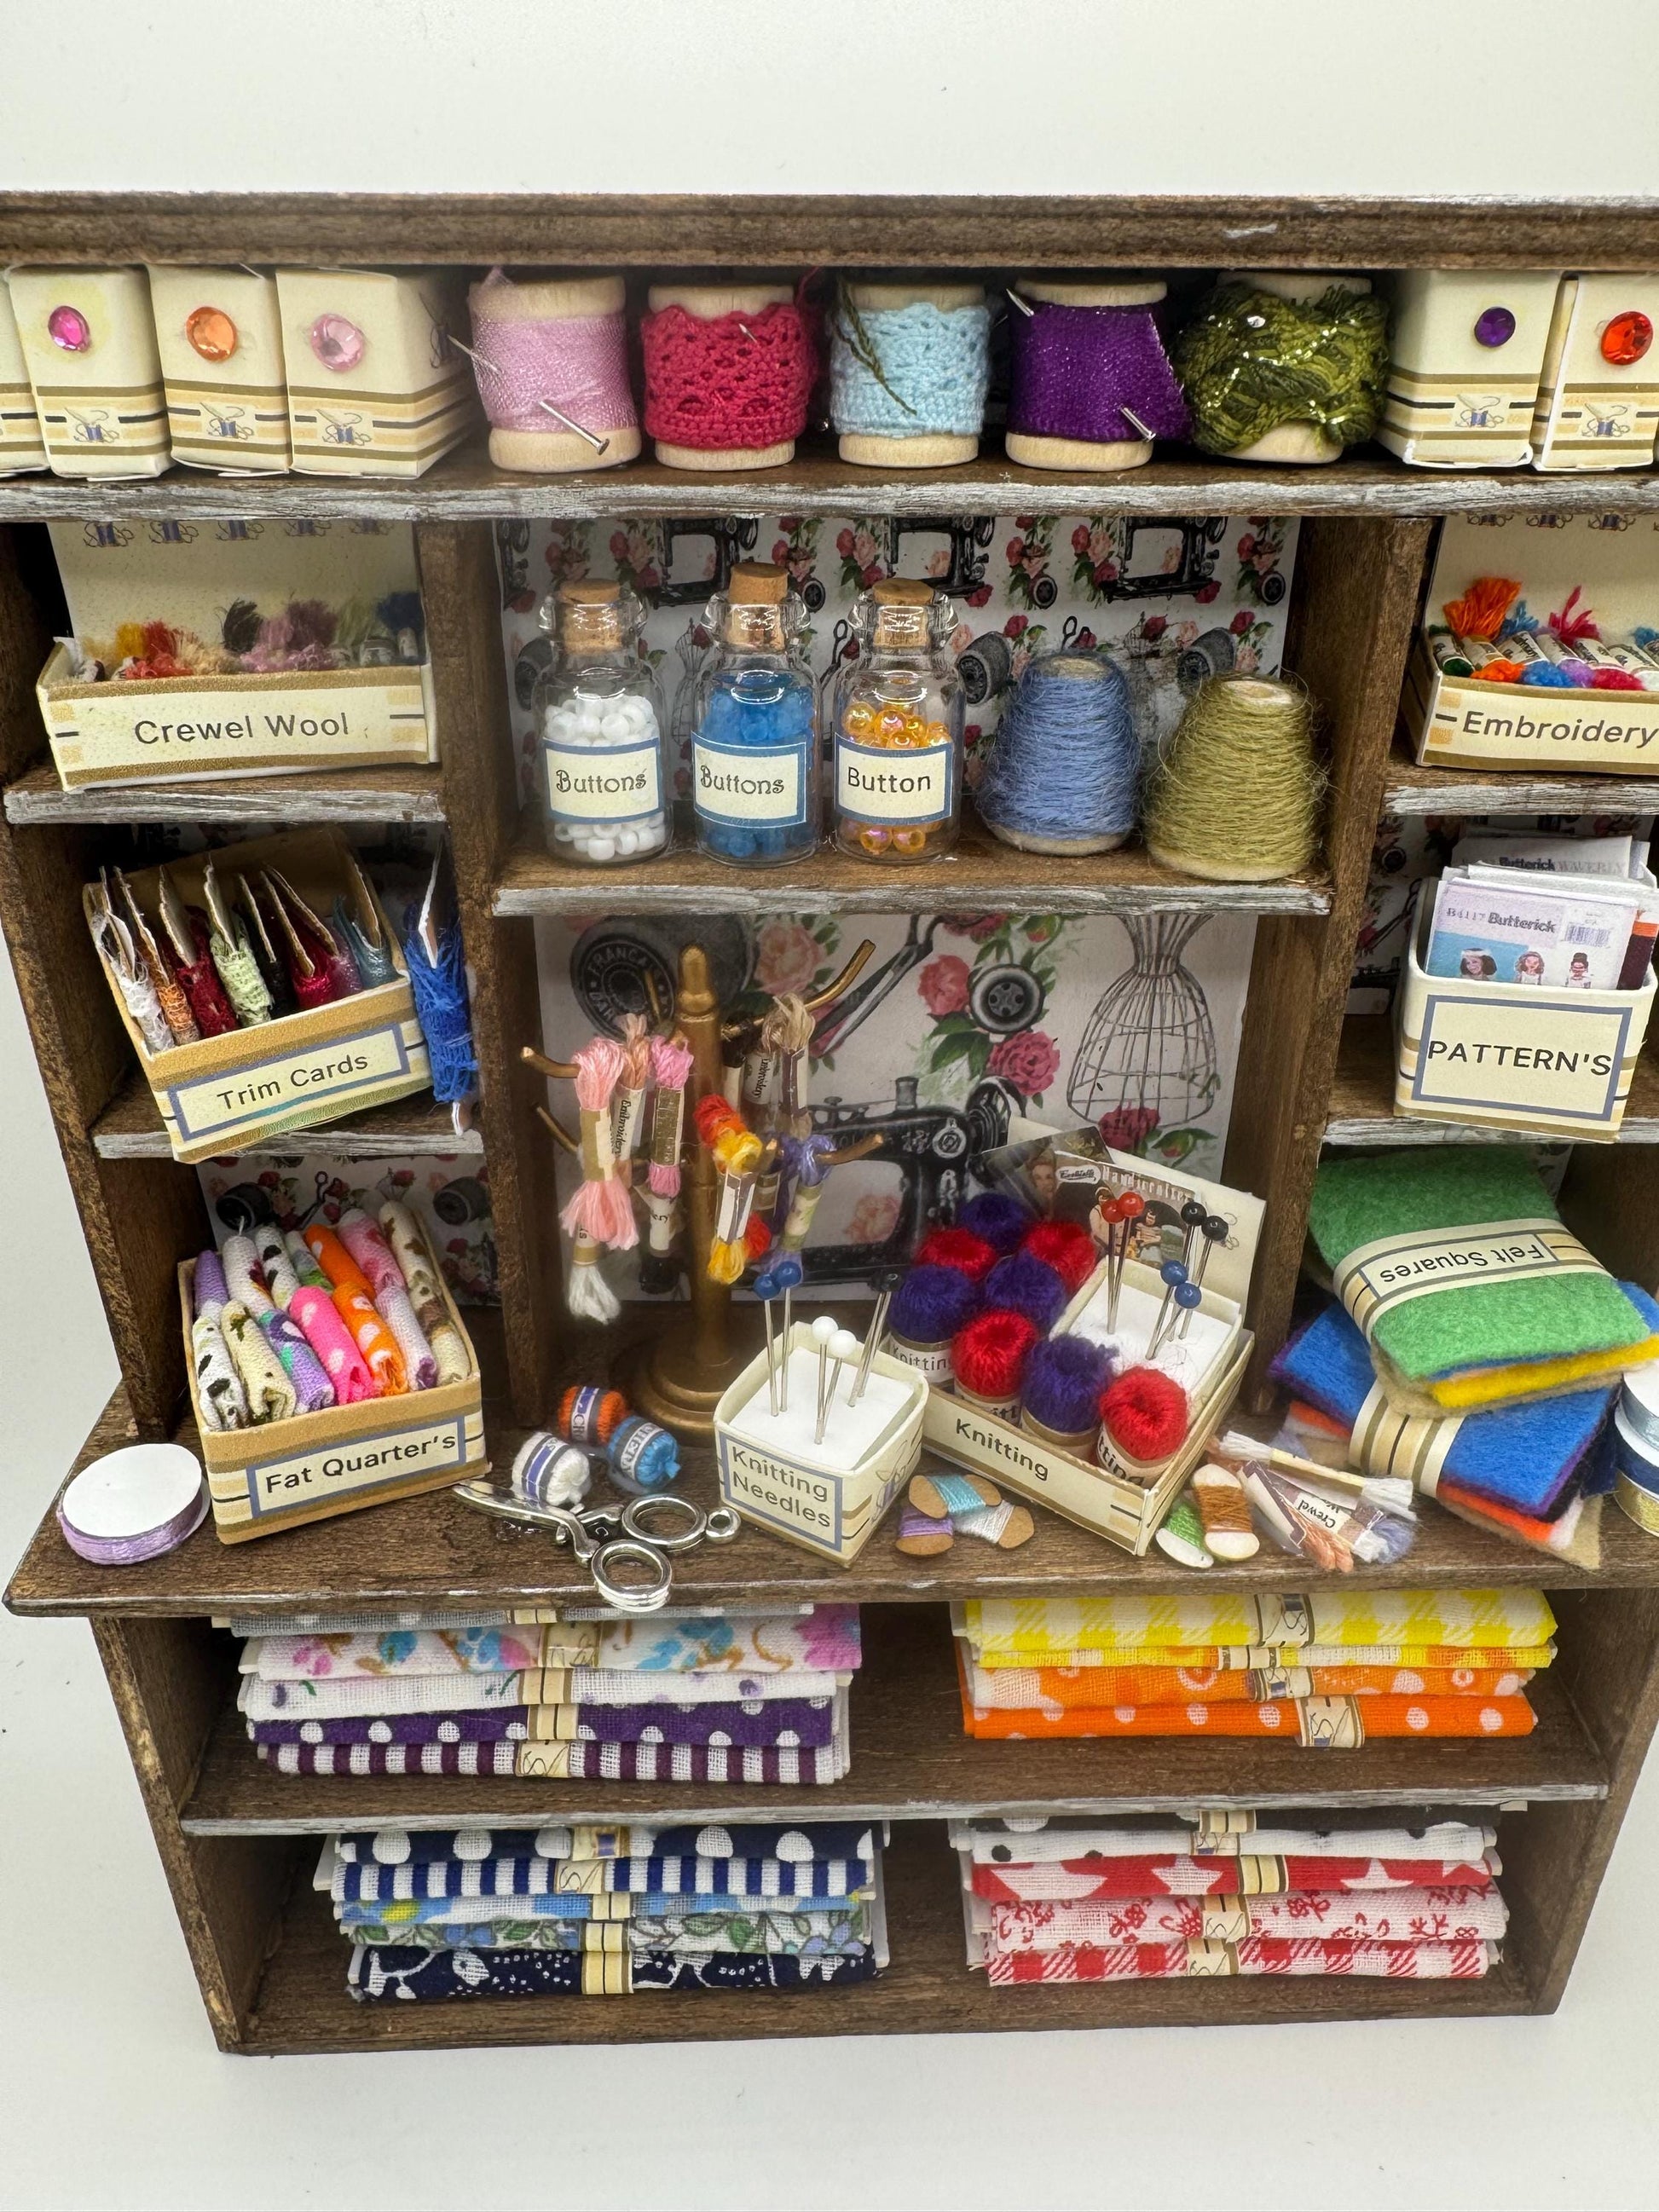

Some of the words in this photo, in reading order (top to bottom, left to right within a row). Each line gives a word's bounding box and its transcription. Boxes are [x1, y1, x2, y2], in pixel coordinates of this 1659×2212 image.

[134, 714, 254, 745] Crewel
[263, 711, 350, 737] Wool
[1462, 709, 1659, 749] Embroidery
[555, 767, 648, 794] Buttons
[699, 765, 785, 795] Buttons
[847, 766, 932, 794] Button
[1488, 912, 1557, 933] Butterick
[1427, 1039, 1612, 1077] PATTERN'S
[217, 1079, 281, 1111] Trim
[290, 1054, 369, 1087] Cards
[1379, 1250, 1488, 1283] Squares
[1489, 1244, 1546, 1264] Felt
[265, 1467, 313, 1493] Fat
[321, 1435, 456, 1477] Quarter's
[956, 1418, 1049, 1481] Knitting
[731, 1446, 828, 1504] Knitting
[732, 1470, 830, 1528] Needles
[1299, 1499, 1337, 1529] Crewel
